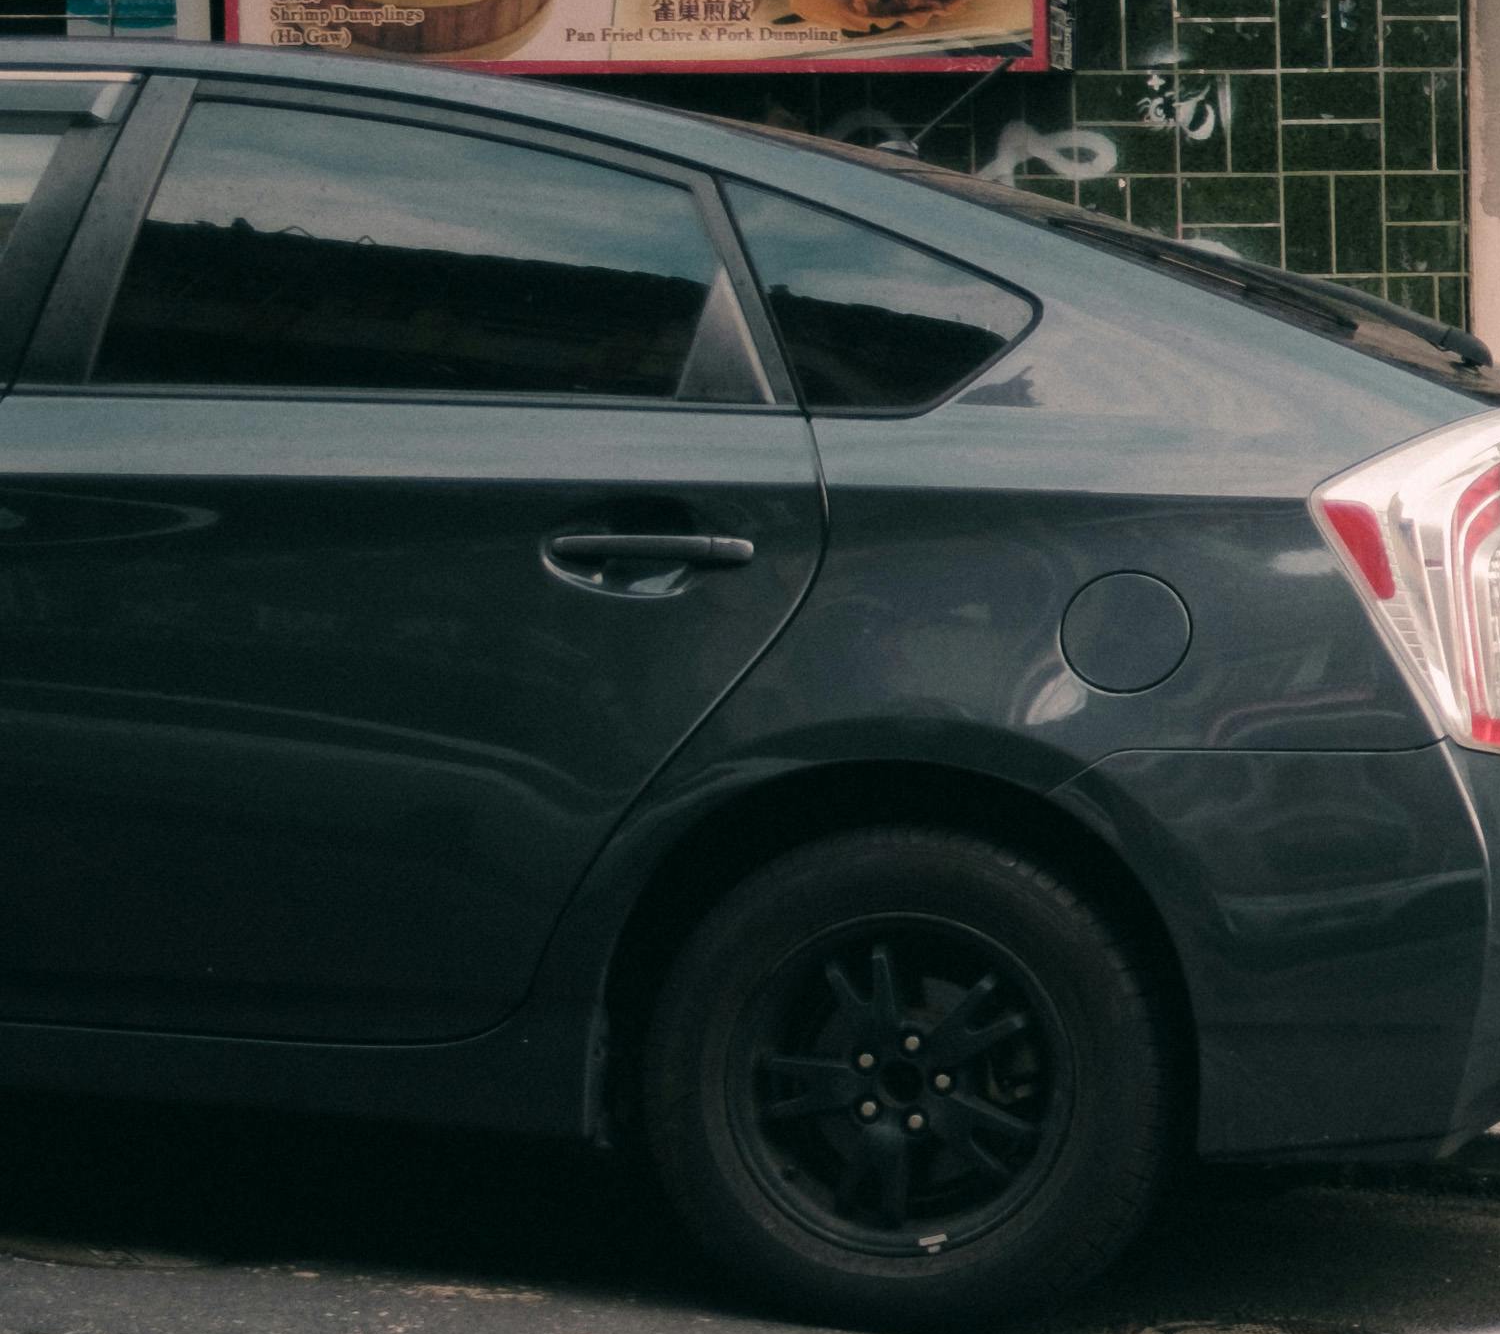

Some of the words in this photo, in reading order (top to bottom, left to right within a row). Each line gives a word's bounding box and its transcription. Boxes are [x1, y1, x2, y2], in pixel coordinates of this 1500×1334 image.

[270, 7, 330, 24] Shrimp
[333, 6, 424, 25] Dumplings
[270, 28, 304, 45] (Ha
[306, 28, 352, 47] Gaw)
[565, 28, 596, 42] Pan
[601, 27, 644, 42] Fried
[649, 27, 694, 42] Chive
[699, 28, 712, 42] &
[717, 27, 753, 42] Pork
[759, 27, 839, 44] Dumpling
